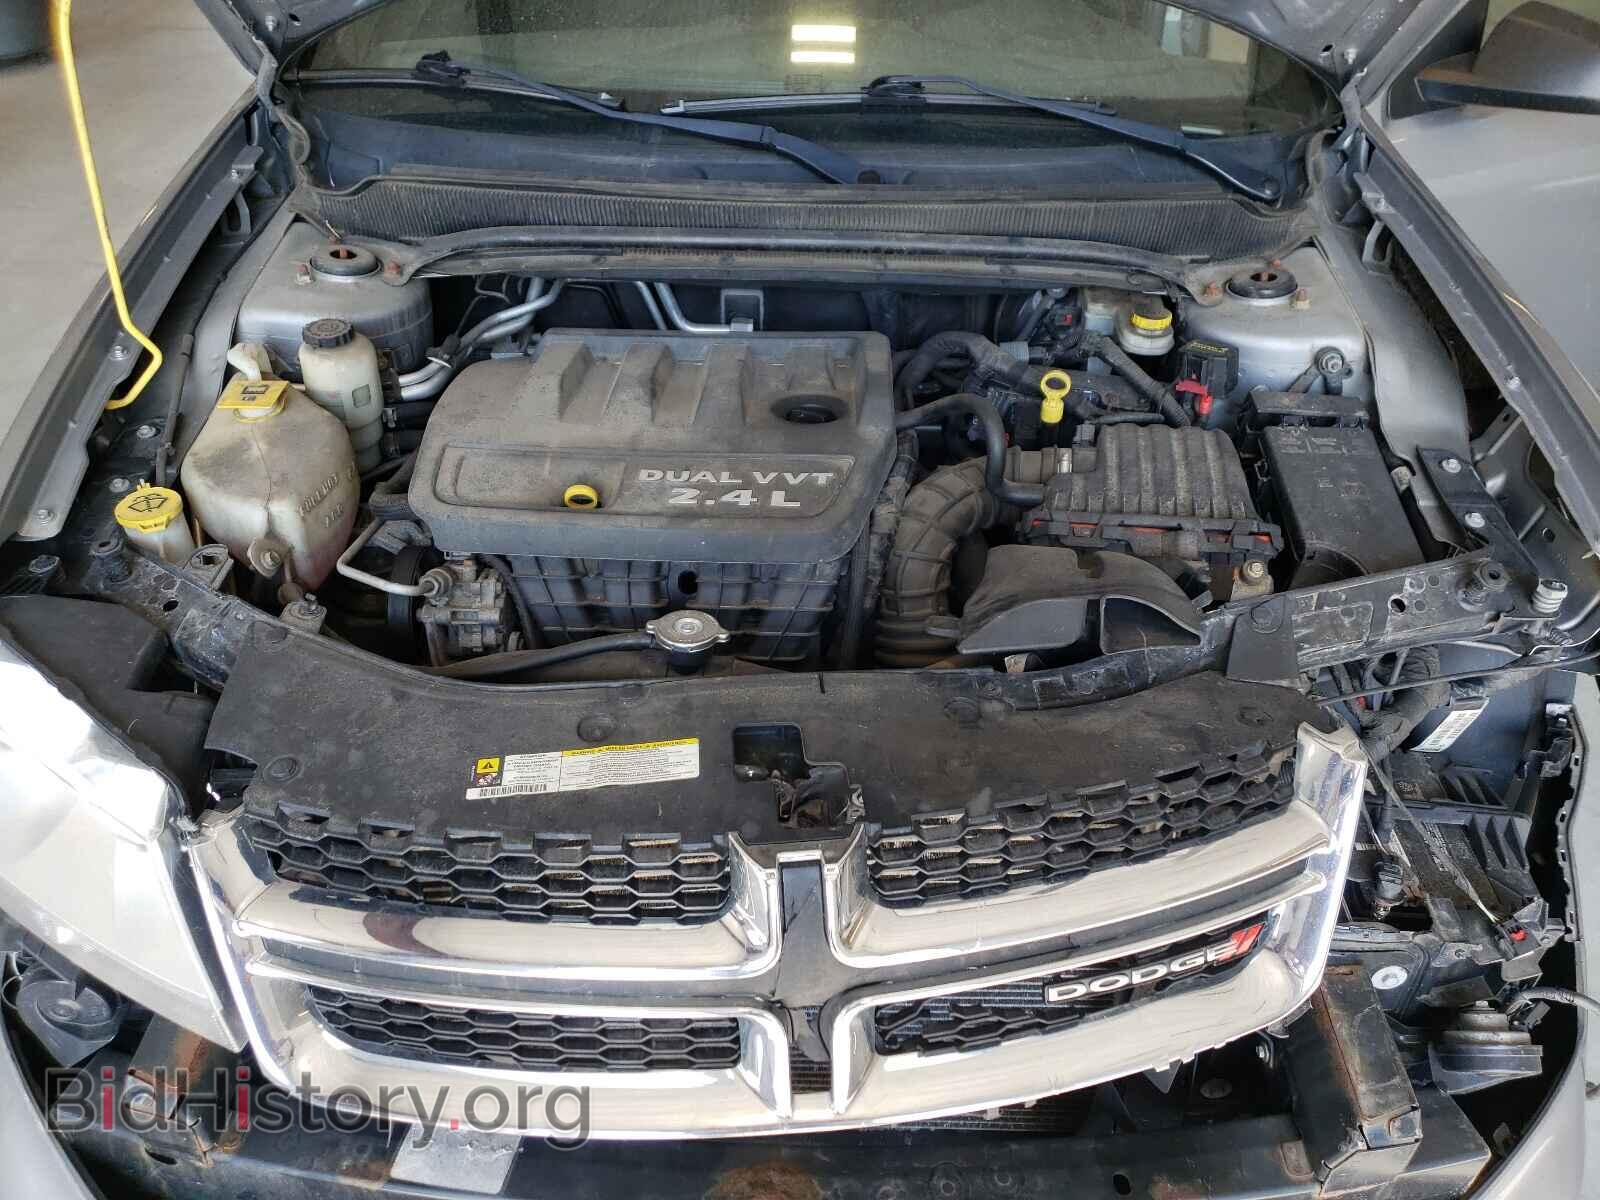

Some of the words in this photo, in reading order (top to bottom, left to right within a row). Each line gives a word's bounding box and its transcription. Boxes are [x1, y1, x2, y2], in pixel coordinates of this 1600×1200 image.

[638, 469, 743, 483] DUAL
[752, 471, 834, 485] VVT
[668, 487, 759, 506] 2.4
[771, 490, 801, 507] L
[1048, 941, 1236, 1002] DODGE
